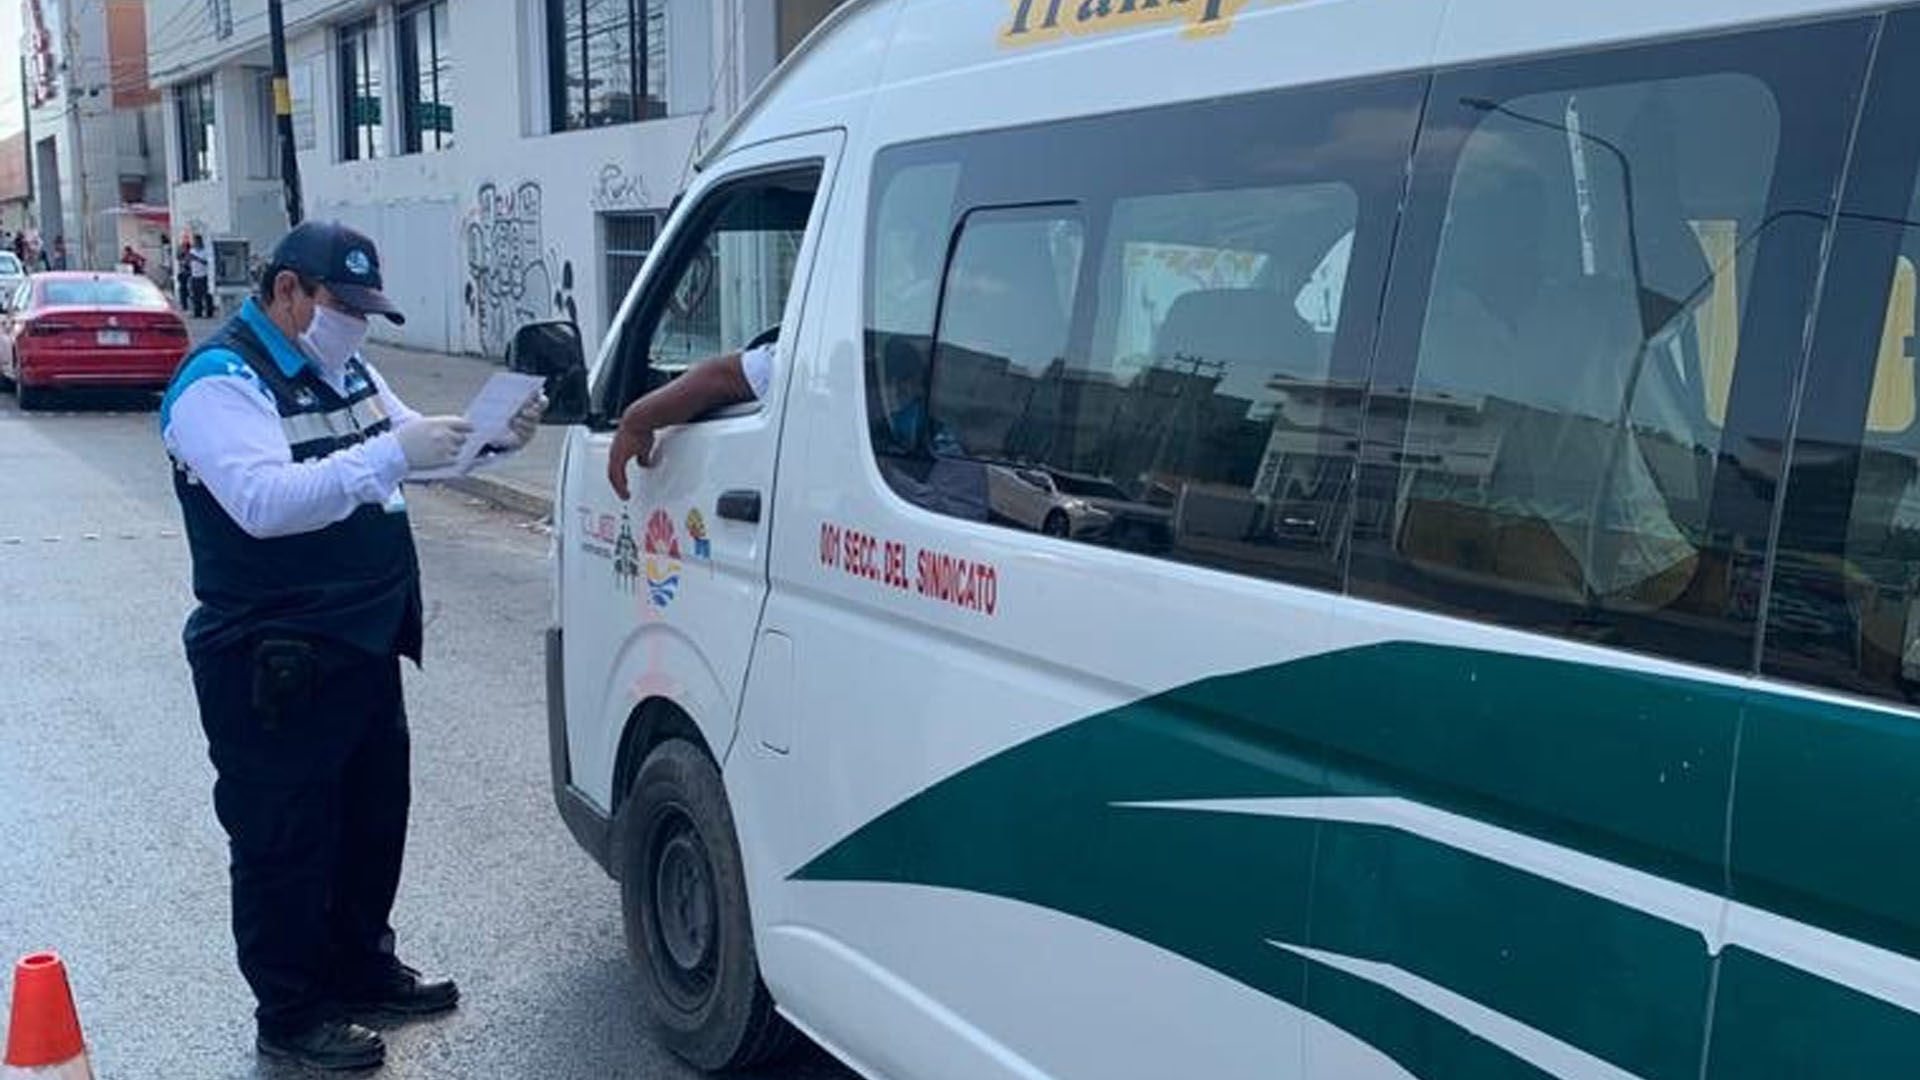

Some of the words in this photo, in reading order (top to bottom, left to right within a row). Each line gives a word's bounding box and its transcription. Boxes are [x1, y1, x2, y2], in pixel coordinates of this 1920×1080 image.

[1005, 0, 1224, 35] Tranp
[820, 522, 840, 568] 001
[844, 529, 881, 581] SECC.
[884, 540, 909, 590] DEL
[917, 548, 997, 616] SINDICATO
